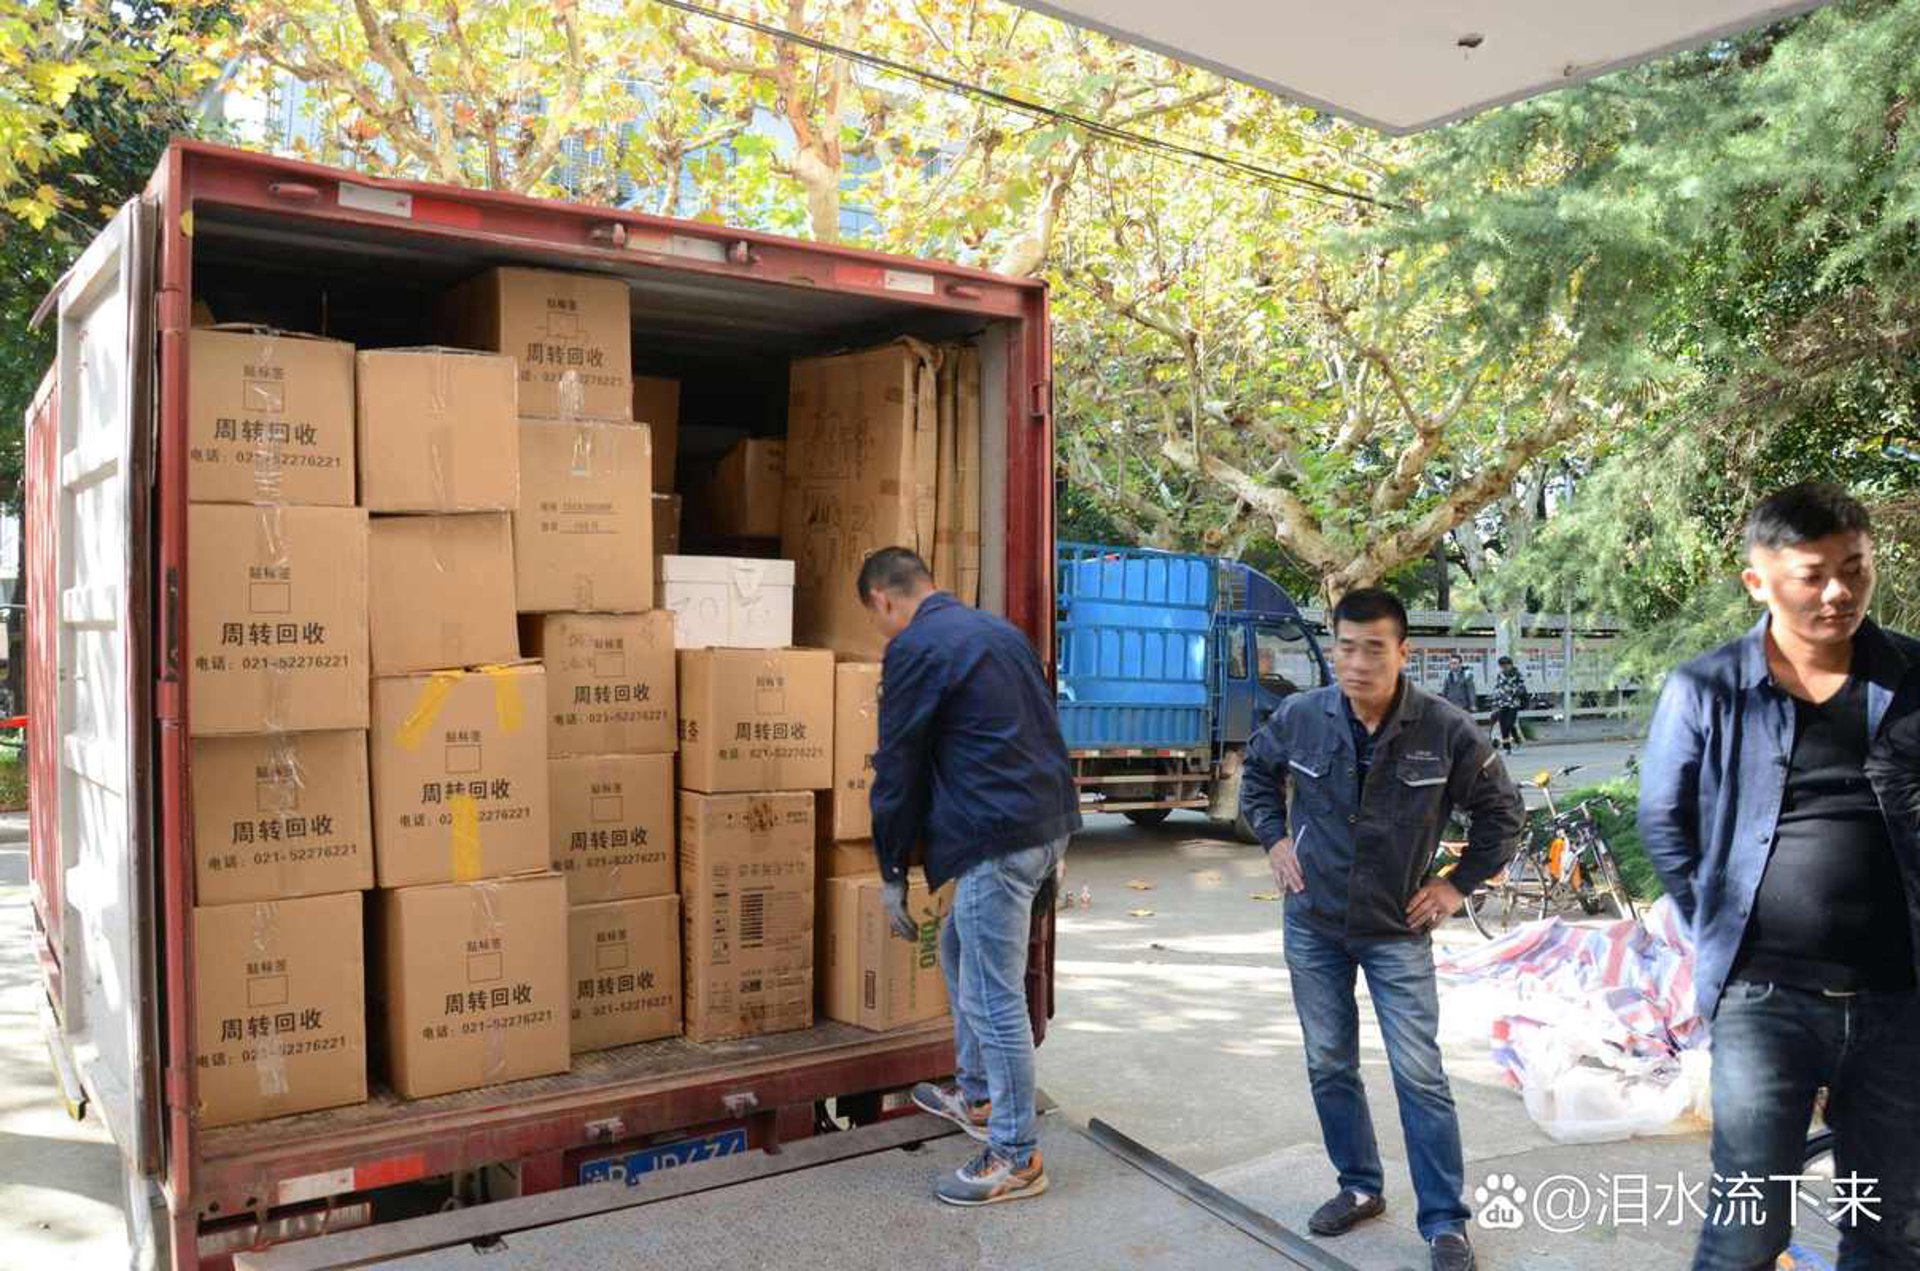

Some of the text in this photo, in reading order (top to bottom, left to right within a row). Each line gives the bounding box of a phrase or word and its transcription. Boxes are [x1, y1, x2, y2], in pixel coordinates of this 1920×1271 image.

[527, 343, 604, 368] 周转回收
[214, 418, 319, 445] 周转回收
[222, 622, 325, 646] 周转回收
[574, 682, 650, 706] 周转回收
[736, 721, 807, 742] 周转回收
[421, 778, 511, 805] 周转回收
[232, 814, 334, 845] 周转回收
[570, 826, 648, 852] 周转回收
[577, 971, 655, 1000] 周转回收
[445, 984, 532, 1016] 周转回收
[221, 1008, 323, 1043] 周转回收
